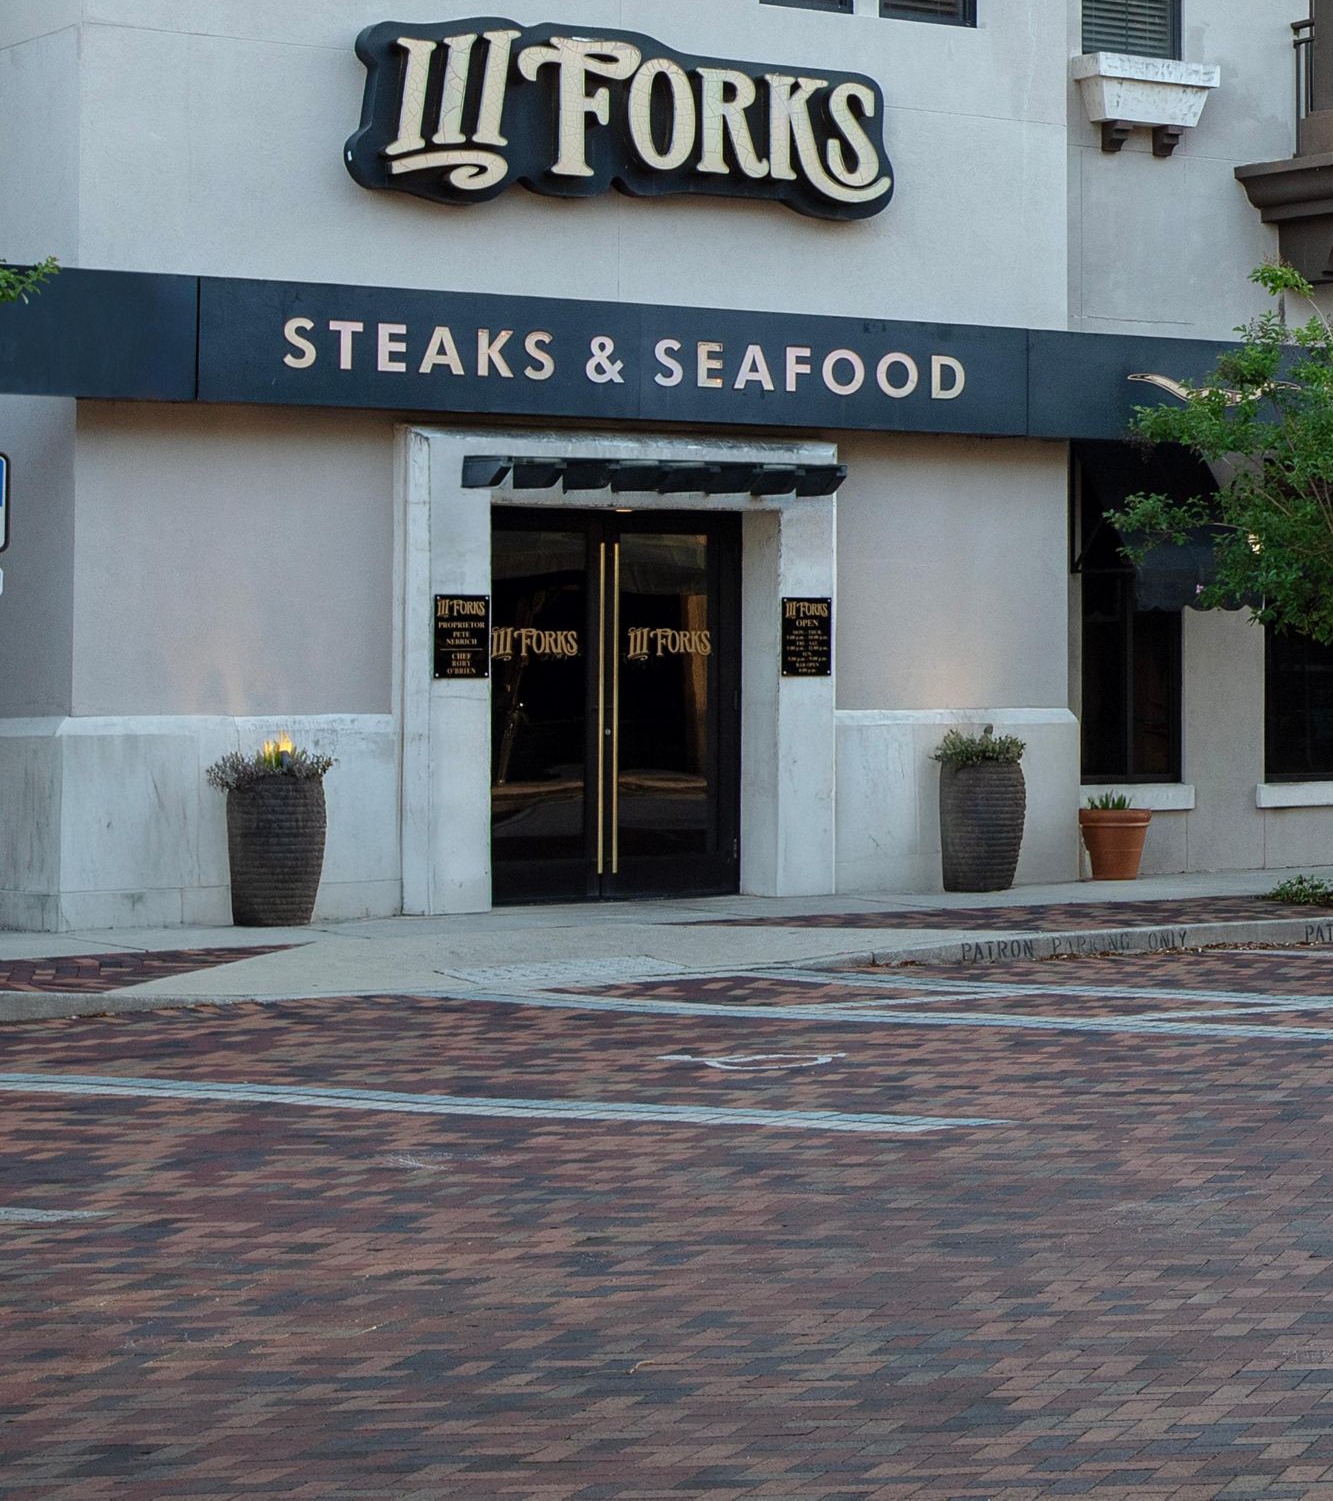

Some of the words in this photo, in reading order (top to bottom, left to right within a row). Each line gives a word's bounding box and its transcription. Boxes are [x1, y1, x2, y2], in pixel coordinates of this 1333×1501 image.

[517, 36, 892, 202] FORKS
[283, 317, 555, 380] STEAKS
[585, 335, 625, 384] &
[654, 338, 966, 400] SEAFOOD
[449, 599, 485, 617] FORKS
[796, 602, 829, 617] FORKS
[438, 621, 485, 629] PROPRIETOR
[795, 619, 819, 627] OPEN
[513, 628, 578, 657] FORKS
[649, 628, 711, 657] FORKS
